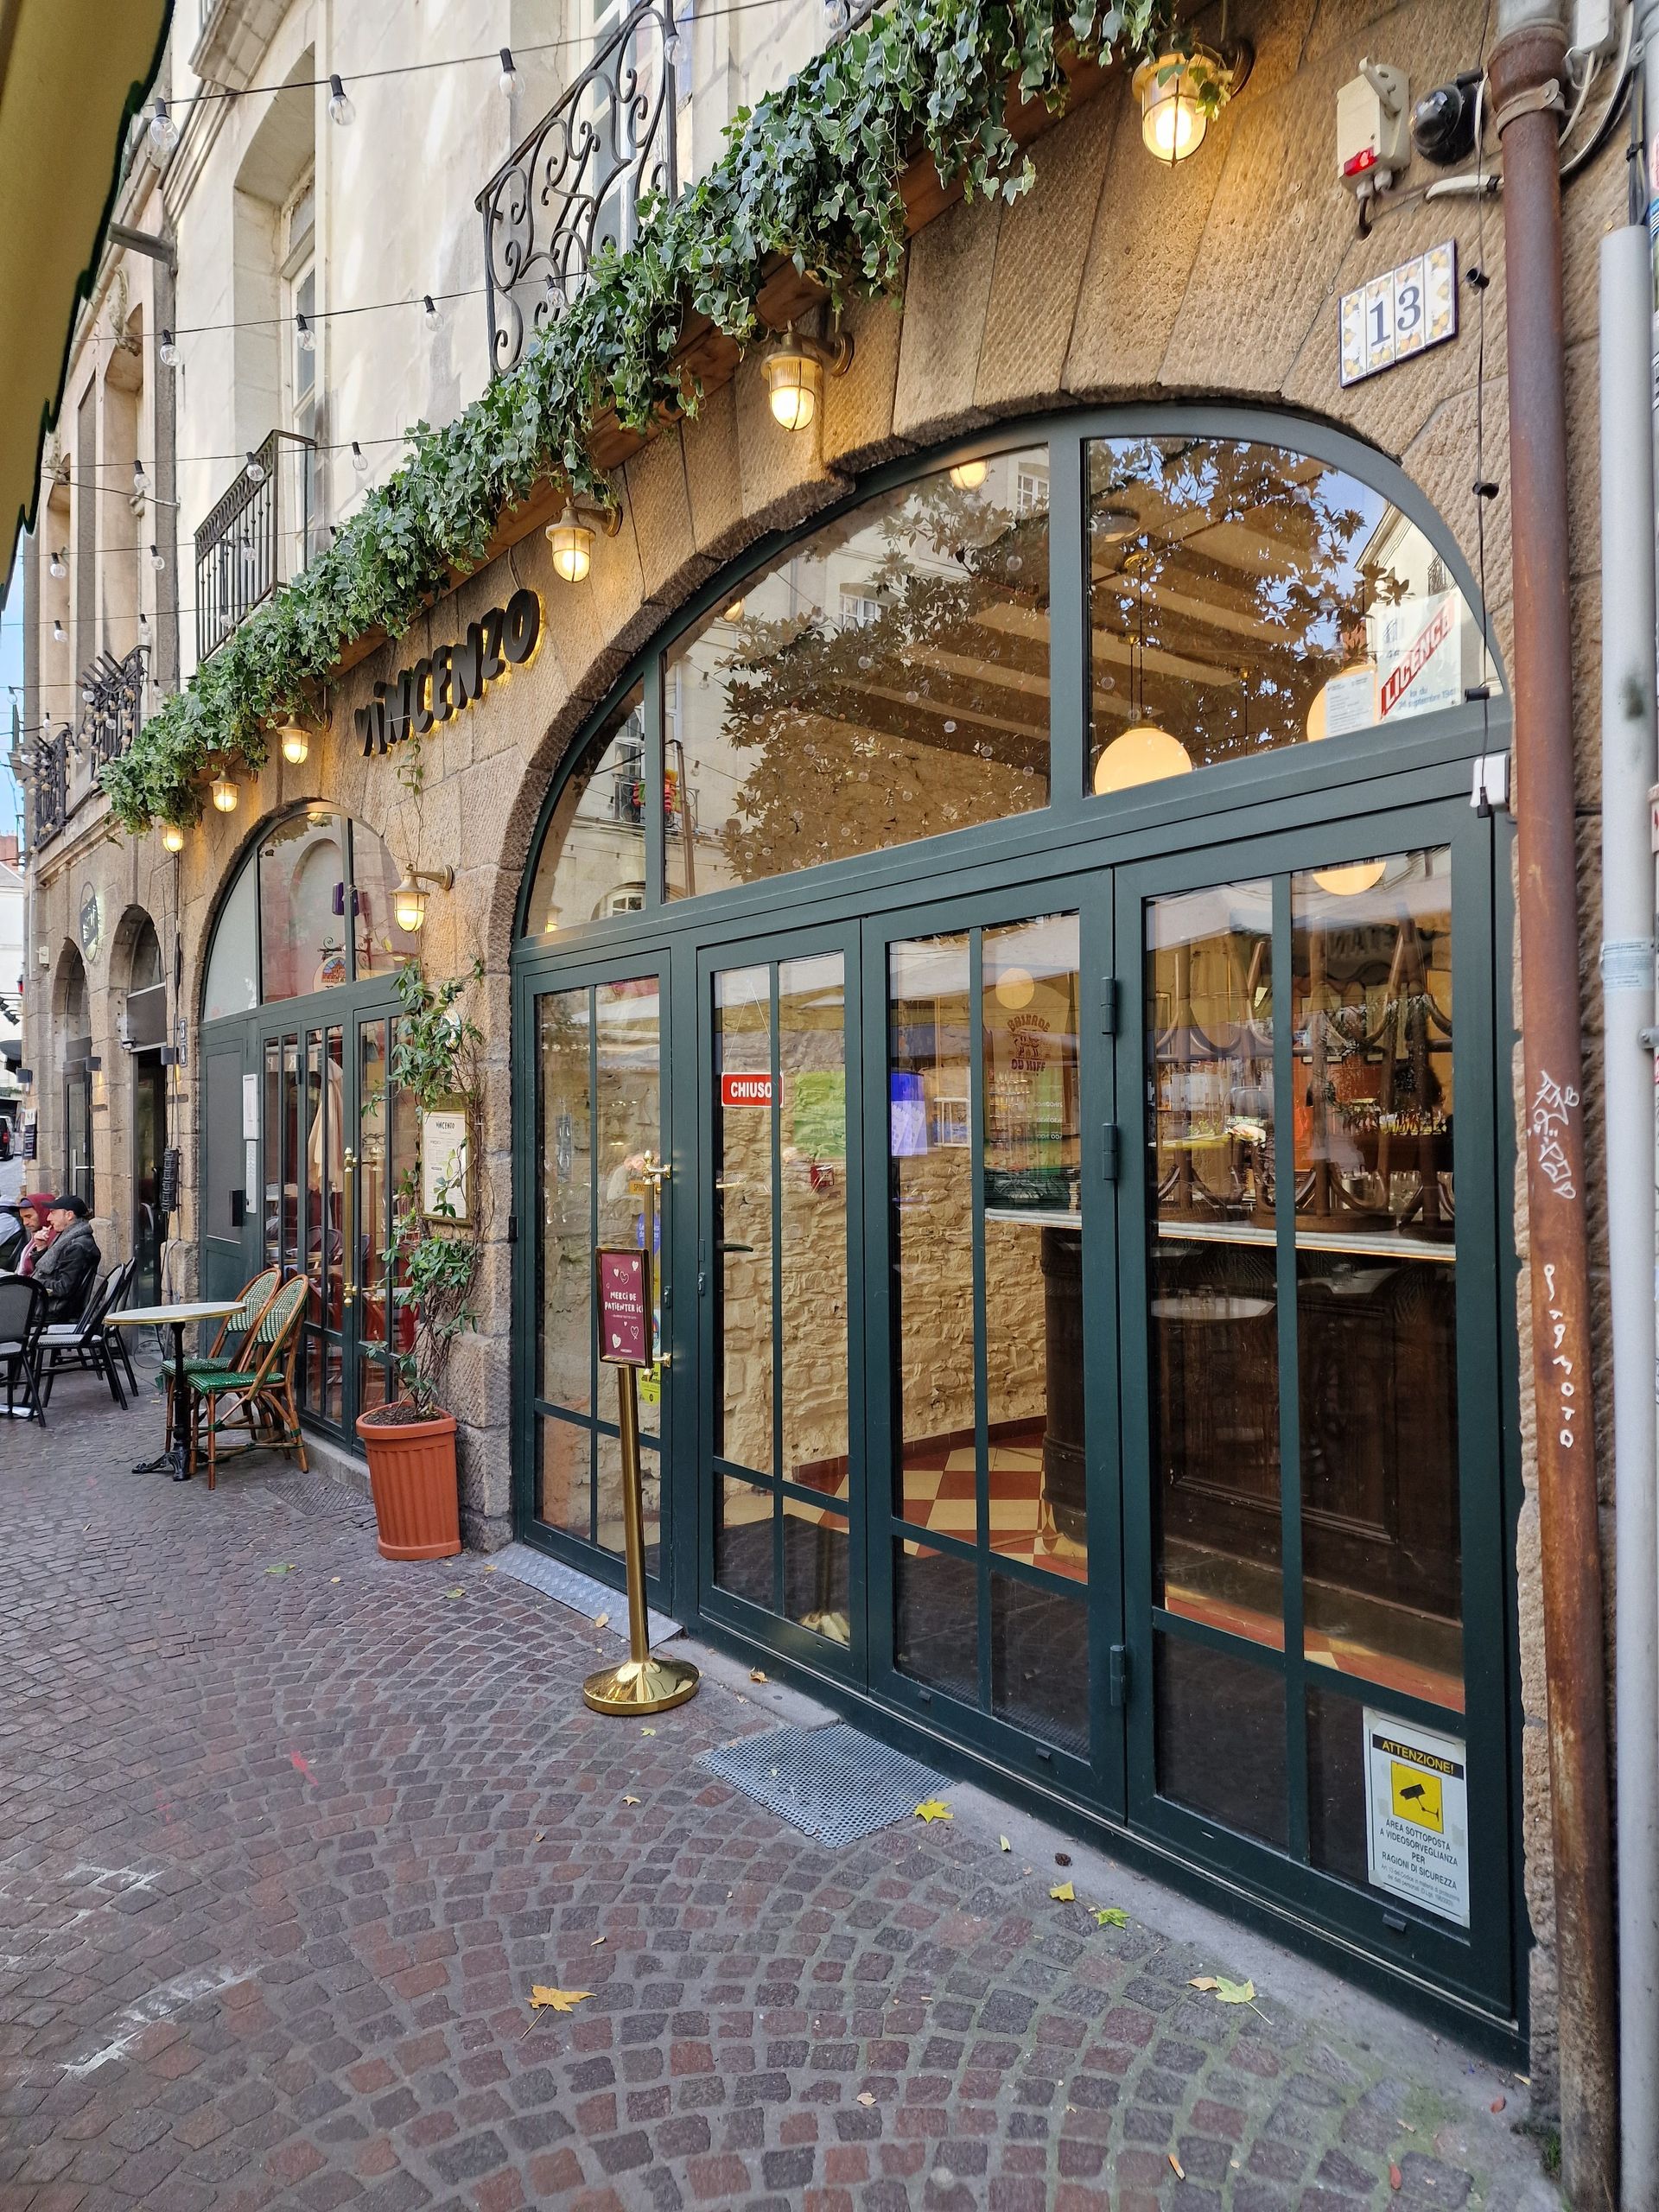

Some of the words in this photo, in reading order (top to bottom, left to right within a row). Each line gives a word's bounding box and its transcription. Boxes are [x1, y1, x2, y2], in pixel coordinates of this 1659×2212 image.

[1370, 285, 1421, 347] 13
[730, 1081, 772, 1098] CHIUSO
[629, 1293, 637, 1301] DE
[1382, 1739, 1454, 1775] ATTENZIONE!
[1385, 1818, 1404, 1833] AREA
[1405, 1826, 1451, 1852] SOTTOPOSTA
[1386, 1829, 1458, 1866] VIDEOSORVEGLIANZA
[1382, 1851, 1409, 1870] RAGIONI
[1410, 1863, 1418, 1873] DI
[1419, 1866, 1458, 1891] SICUREZZA
[1411, 1852, 1426, 1865] PER
